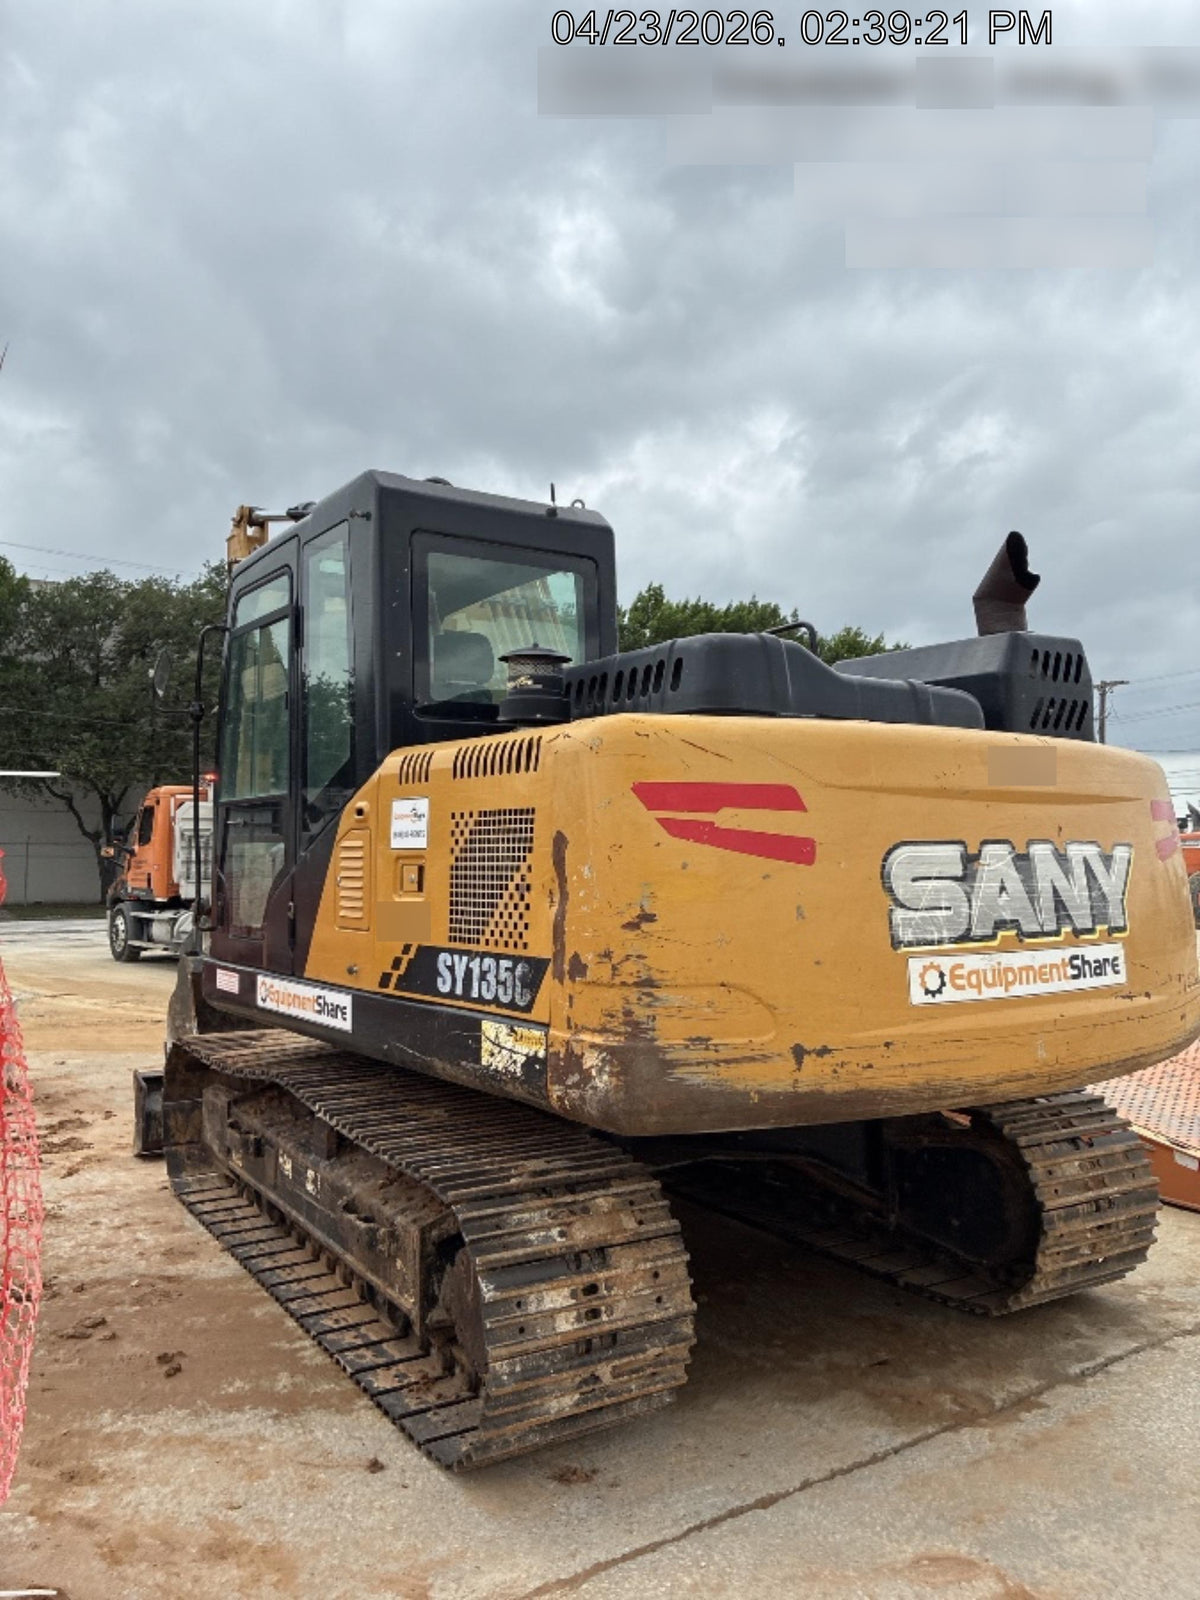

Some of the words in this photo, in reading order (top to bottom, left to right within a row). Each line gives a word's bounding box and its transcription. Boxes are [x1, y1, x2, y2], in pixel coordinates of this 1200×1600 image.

[881, 839, 1134, 951] SANY
[436, 952, 532, 1007] SY135C
[949, 954, 1121, 996] EquipmentShare
[268, 984, 348, 1022] EquipmentShare
